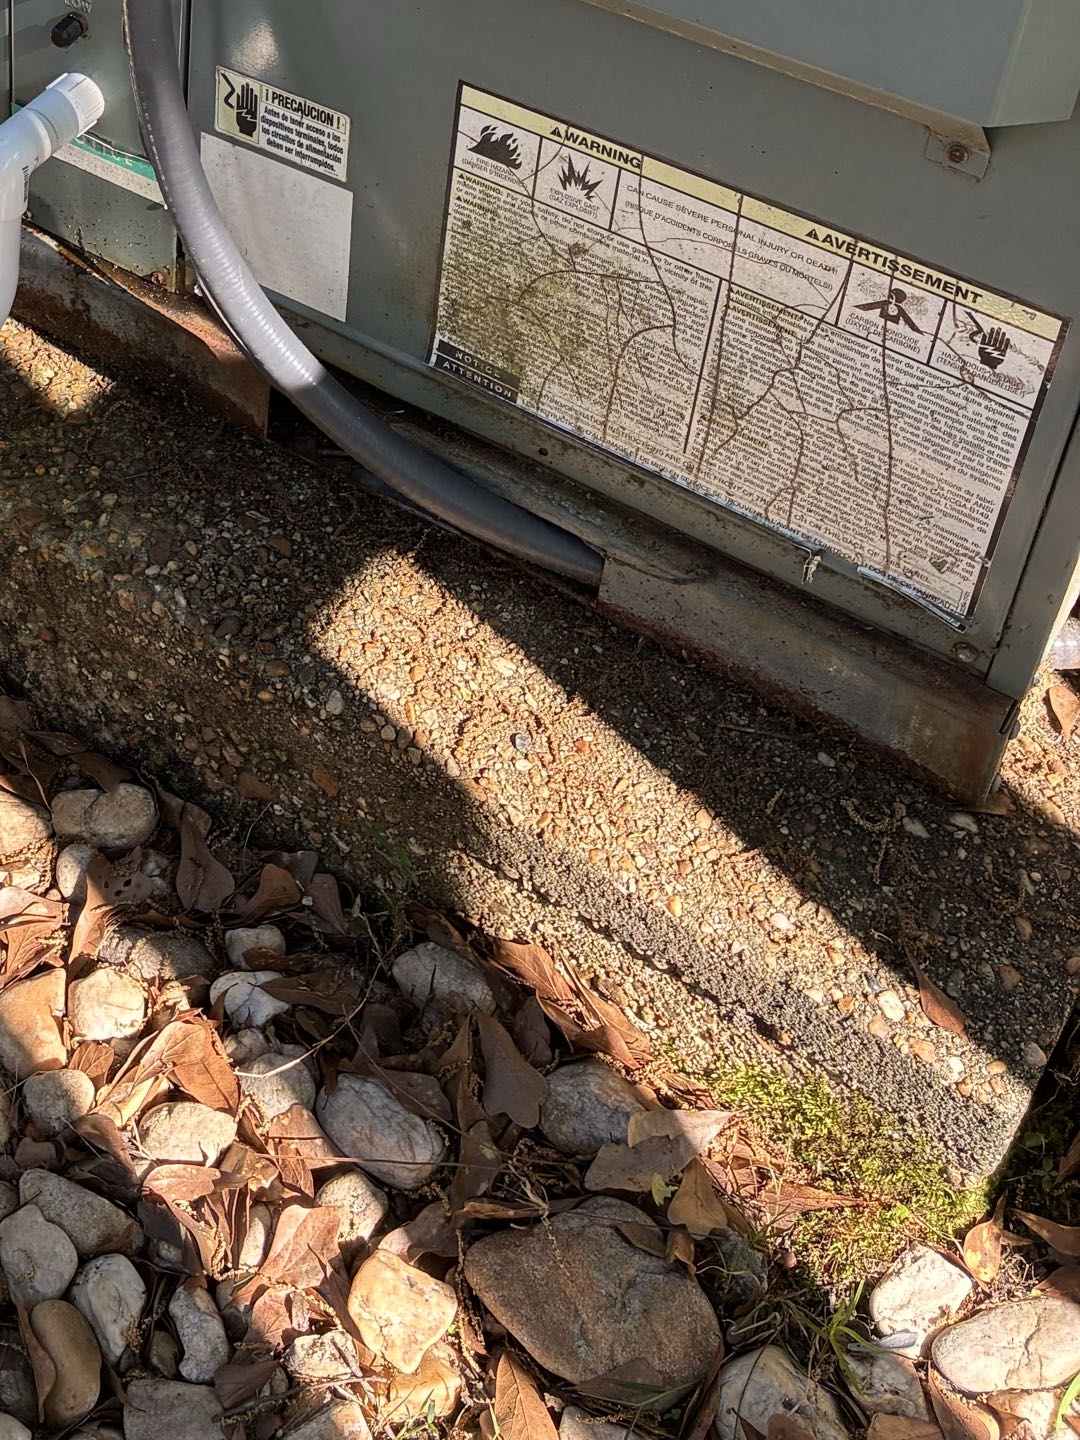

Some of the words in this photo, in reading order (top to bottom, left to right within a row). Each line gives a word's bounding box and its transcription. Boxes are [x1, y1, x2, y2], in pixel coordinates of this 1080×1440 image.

[264, 105, 279, 118] Antes
[281, 112, 288, 122] de
[289, 115, 303, 128] tener
[305, 122, 325, 136] acceso
[332, 131, 340, 142] los
[271, 91, 333, 127] PRECAUCION
[260, 114, 293, 135] dispositivos
[327, 140, 343, 154] todos
[261, 125, 269, 135] los
[271, 129, 295, 145] circuitos
[296, 138, 303, 149] de
[305, 142, 341, 163] alimentación
[564, 129, 642, 170] WARNING
[266, 137, 283, 151] deben
[284, 144, 293, 155] ser
[294, 148, 335, 173] interrumpidos.
[549, 187, 582, 206] EXPLOSIVE
[506, 192, 518, 202] For
[572, 220, 584, 230] not
[616, 239, 630, 250] use
[645, 191, 674, 209] CAUSE
[757, 236, 788, 255] INJURY
[789, 249, 804, 261] OR
[549, 218, 569, 231] other
[611, 244, 640, 261] material
[663, 266, 689, 283] vicinity
[699, 281, 713, 292] this
[823, 233, 982, 306] AVERTISSEMENT
[686, 294, 709, 309] repair,
[849, 312, 879, 330] CARBON
[829, 329, 869, 352] entreposer
[915, 366, 951, 386] l'essence
[442, 357, 511, 401] ATTENTION
[816, 342, 858, 365] installation,
[921, 387, 970, 413] modification,
[984, 414, 1020, 434] entretien
[831, 357, 861, 375] peuvent
[915, 393, 960, 418] dommages
[1001, 430, 1017, 441] des
[835, 340, 870, 361] voisinage
[894, 365, 925, 384] appareil
[945, 387, 961, 398] tout
[982, 403, 1017, 424] appareil.
[902, 420, 921, 431] vous
[921, 428, 950, 444] courrez
[916, 403, 930, 413] par
[965, 422, 985, 436] dans
[986, 432, 999, 442] les
[1000, 439, 1014, 449] cas
[971, 433, 1012, 456] condensa-
[918, 449, 956, 471] anomalies
[968, 473, 1001, 493] système
[920, 435, 961, 459] dégageant
[961, 454, 974, 465] par
[985, 464, 1005, 477] com-
[995, 452, 1010, 463] mis
[920, 468, 962, 492] instructions
[975, 493, 996, 507] fabri-
[946, 489, 971, 504] norme
[972, 499, 993, 514] ANSI
[944, 502, 989, 527] L'installation
